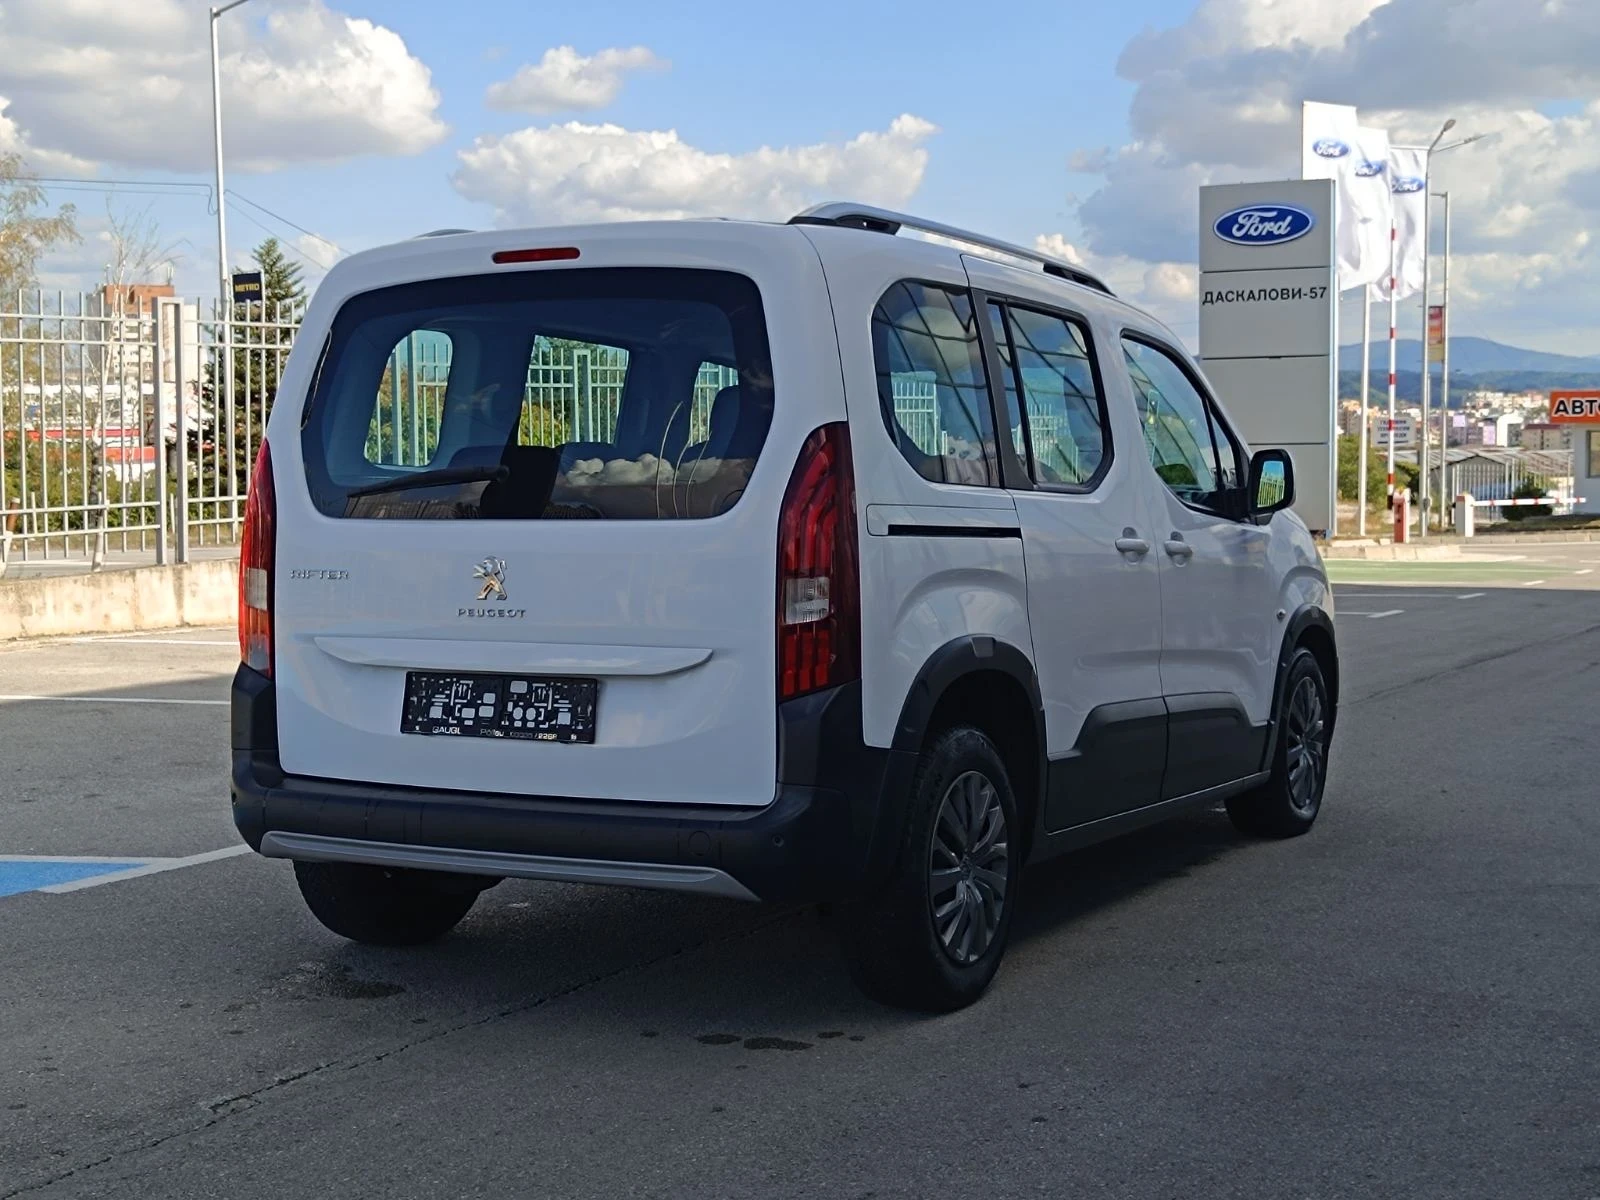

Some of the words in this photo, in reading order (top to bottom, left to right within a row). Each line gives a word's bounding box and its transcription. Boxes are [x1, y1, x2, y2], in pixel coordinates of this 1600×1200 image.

[1231, 210, 1293, 238] Ford
[235, 283, 259, 292] METRO
[1202, 286, 1328, 305] ДАСКАЛОВИ-57
[1553, 399, 1600, 415] АВТ
[290, 568, 350, 580] RIFTER
[456, 607, 527, 618] PEUGEOT
